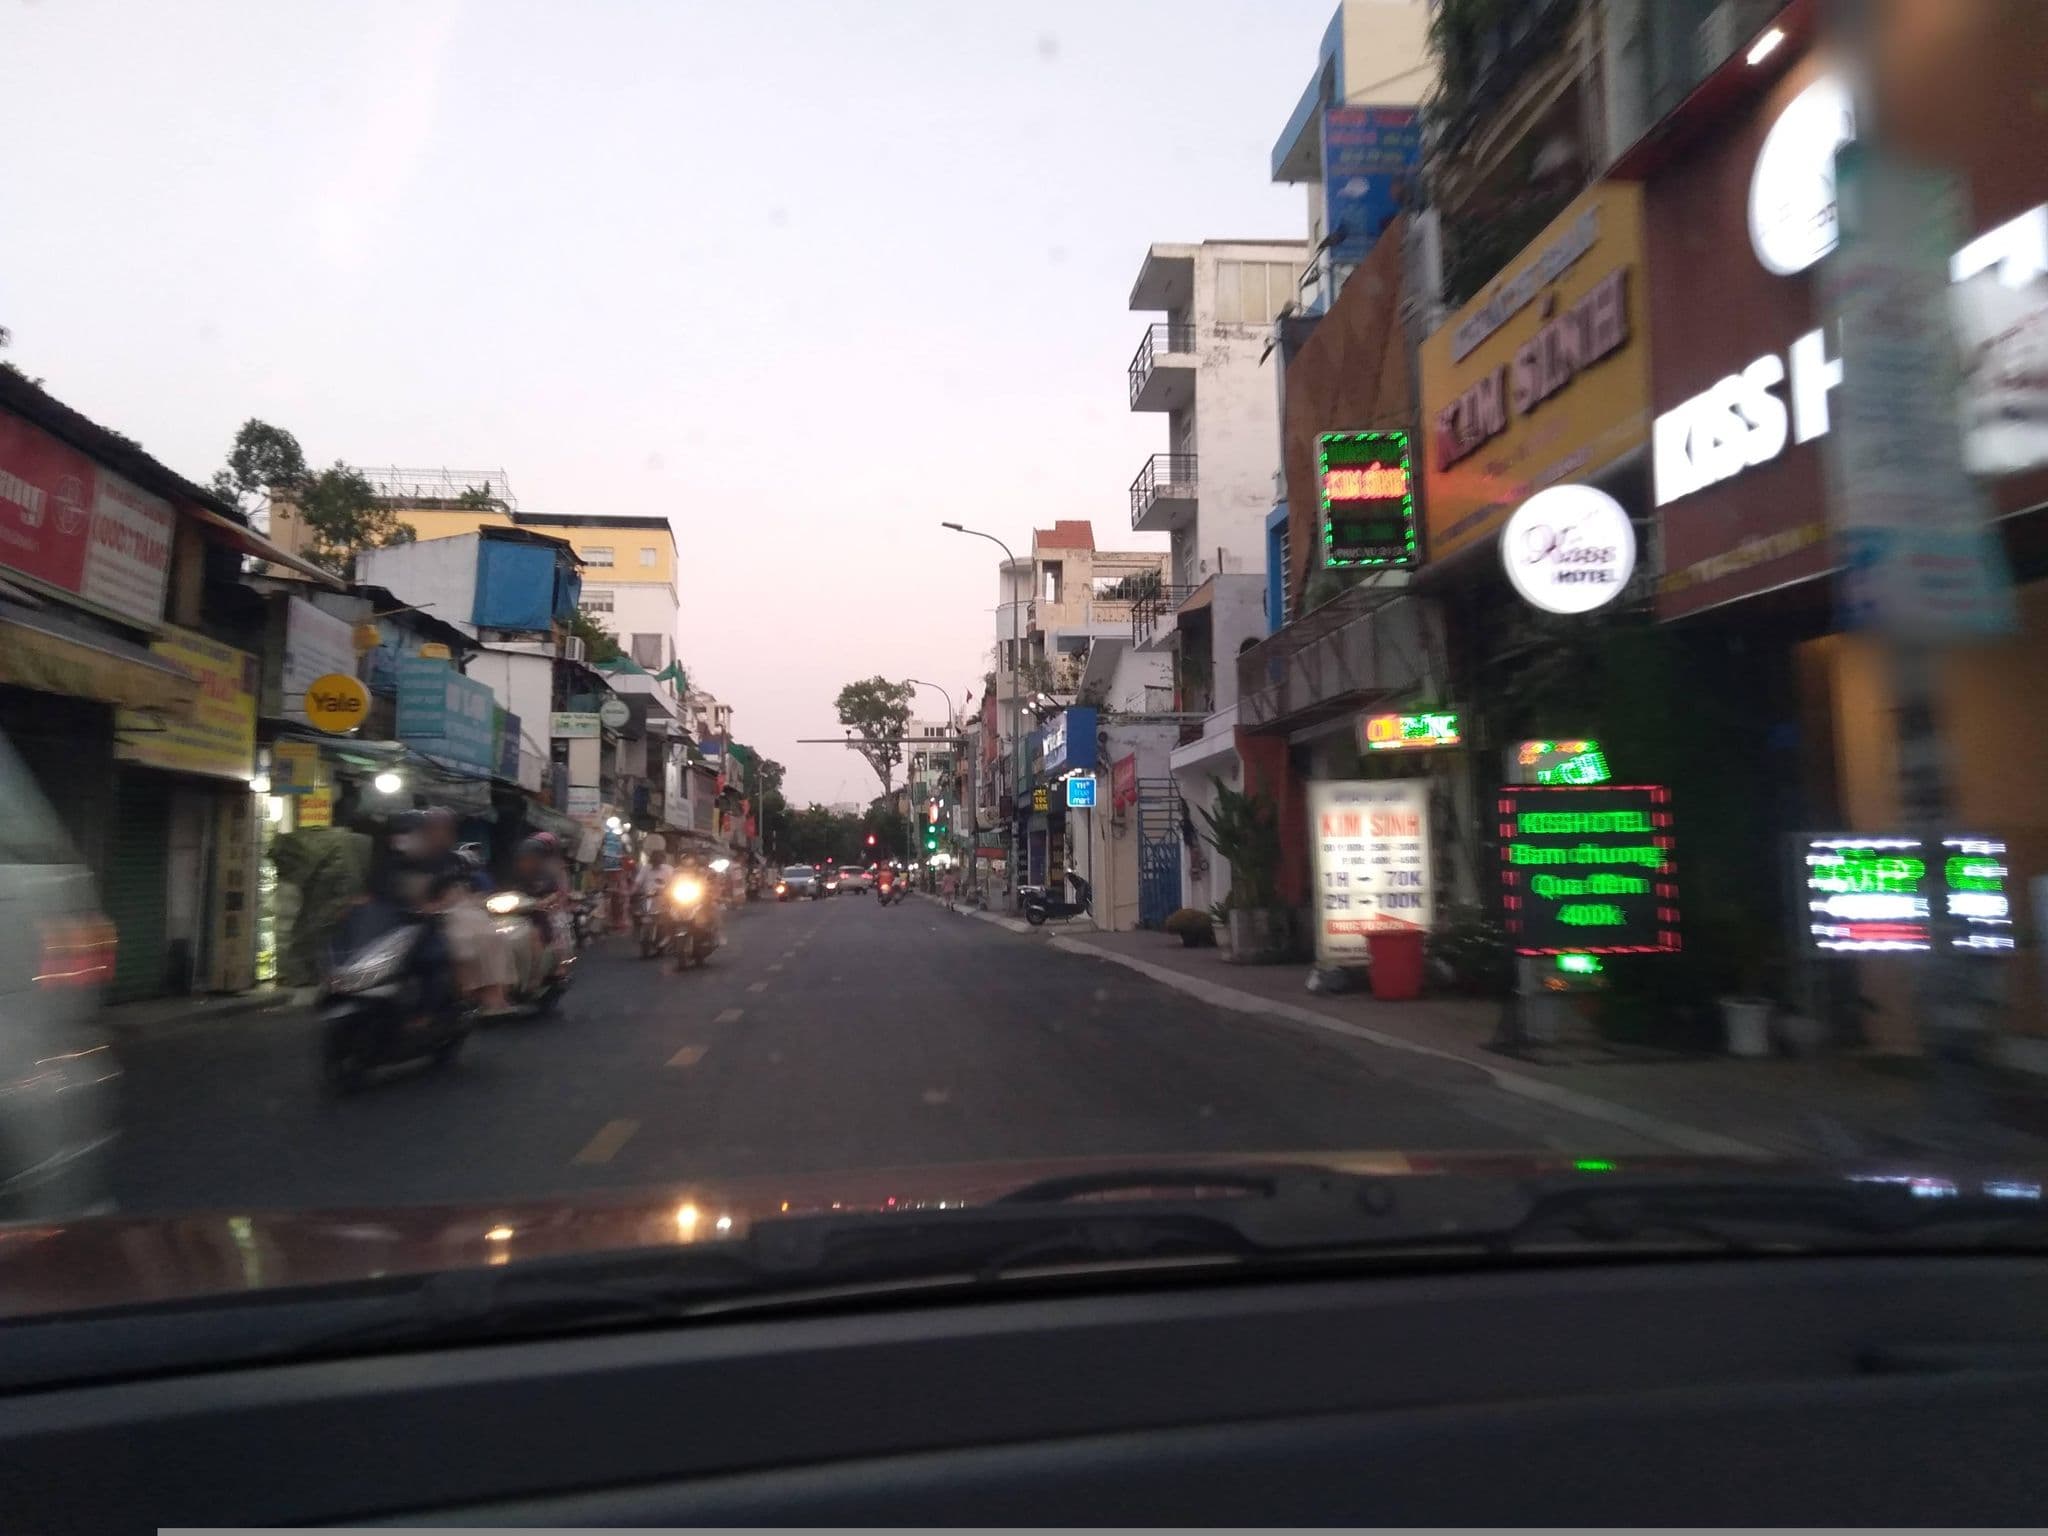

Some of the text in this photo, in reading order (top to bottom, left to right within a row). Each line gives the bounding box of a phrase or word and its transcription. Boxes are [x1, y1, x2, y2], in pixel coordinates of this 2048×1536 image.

[311, 691, 362, 713] Yale
[1072, 796, 1091, 804] mart
[1320, 812, 1361, 837] KIM
[1384, 871, 1421, 887] 70K
